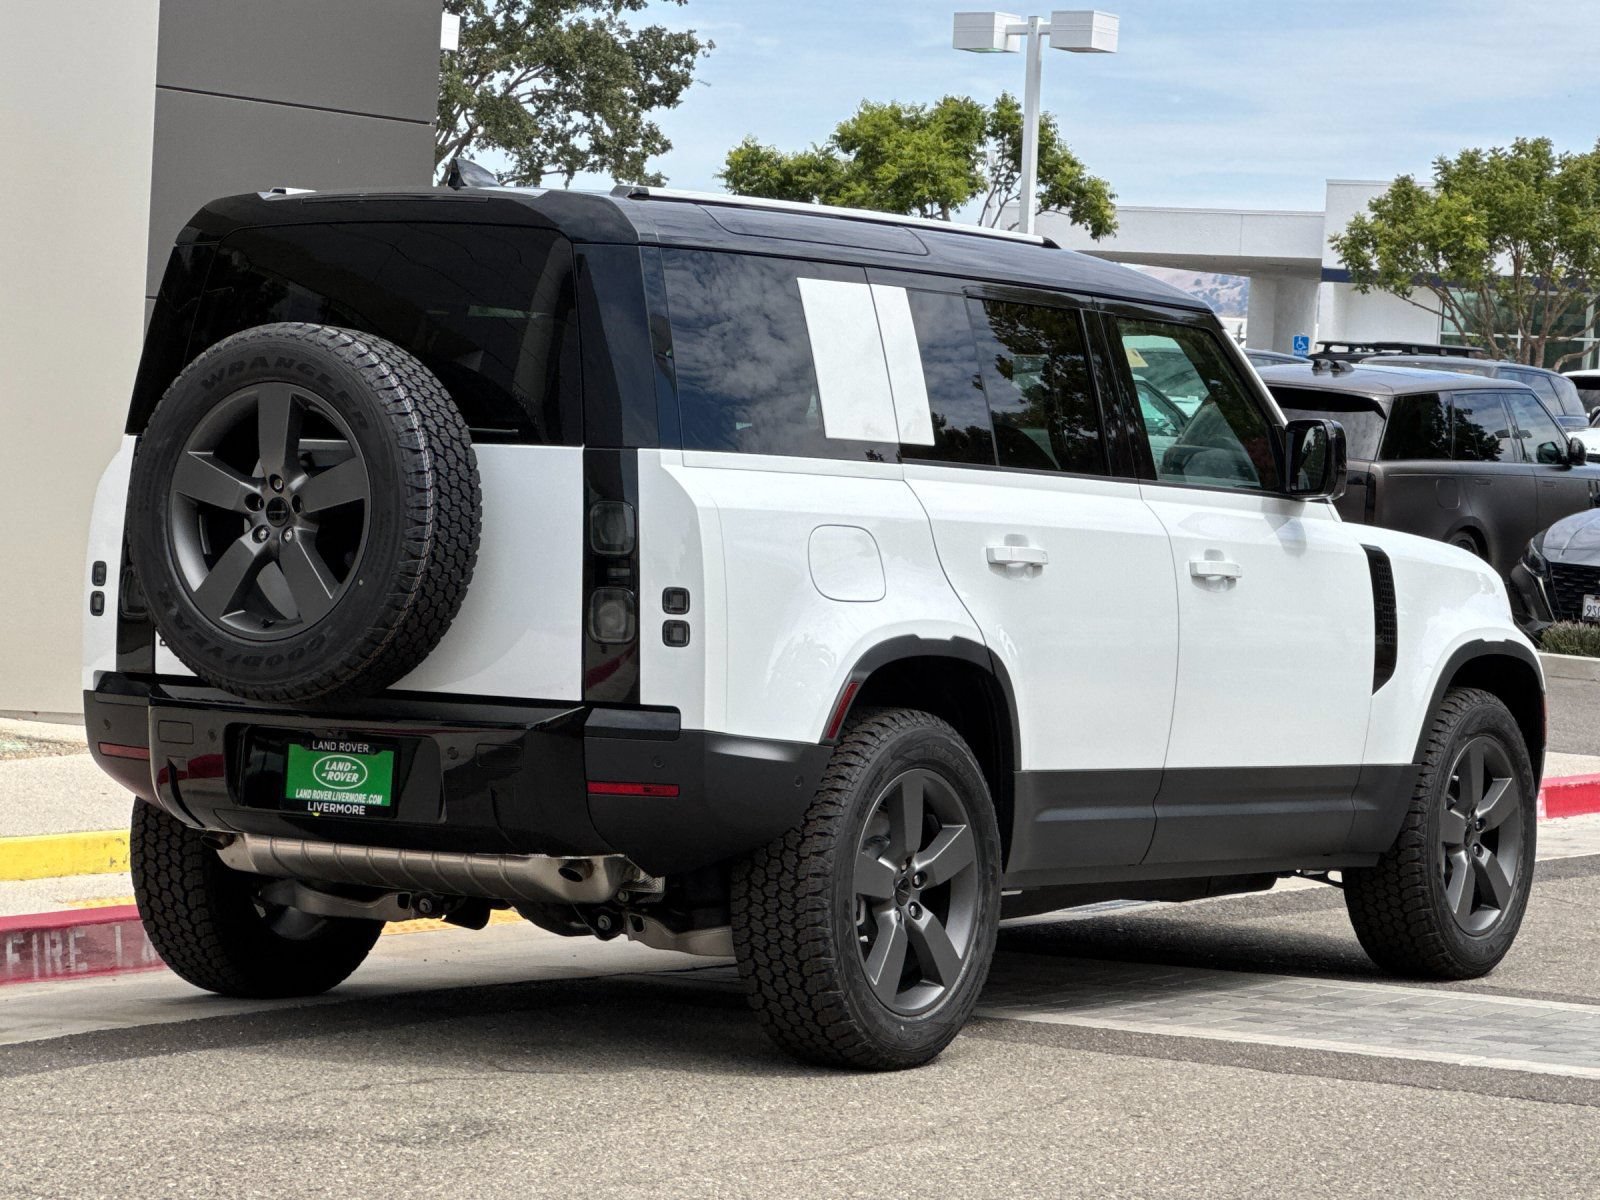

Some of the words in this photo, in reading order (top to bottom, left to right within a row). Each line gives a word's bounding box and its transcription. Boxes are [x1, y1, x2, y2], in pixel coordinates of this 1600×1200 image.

[200, 356, 369, 430] WRANGLER
[312, 740, 337, 751] LAND
[339, 742, 370, 753] ROVER
[307, 801, 366, 815] LIVERMORE
[6, 928, 88, 979] FIRE
